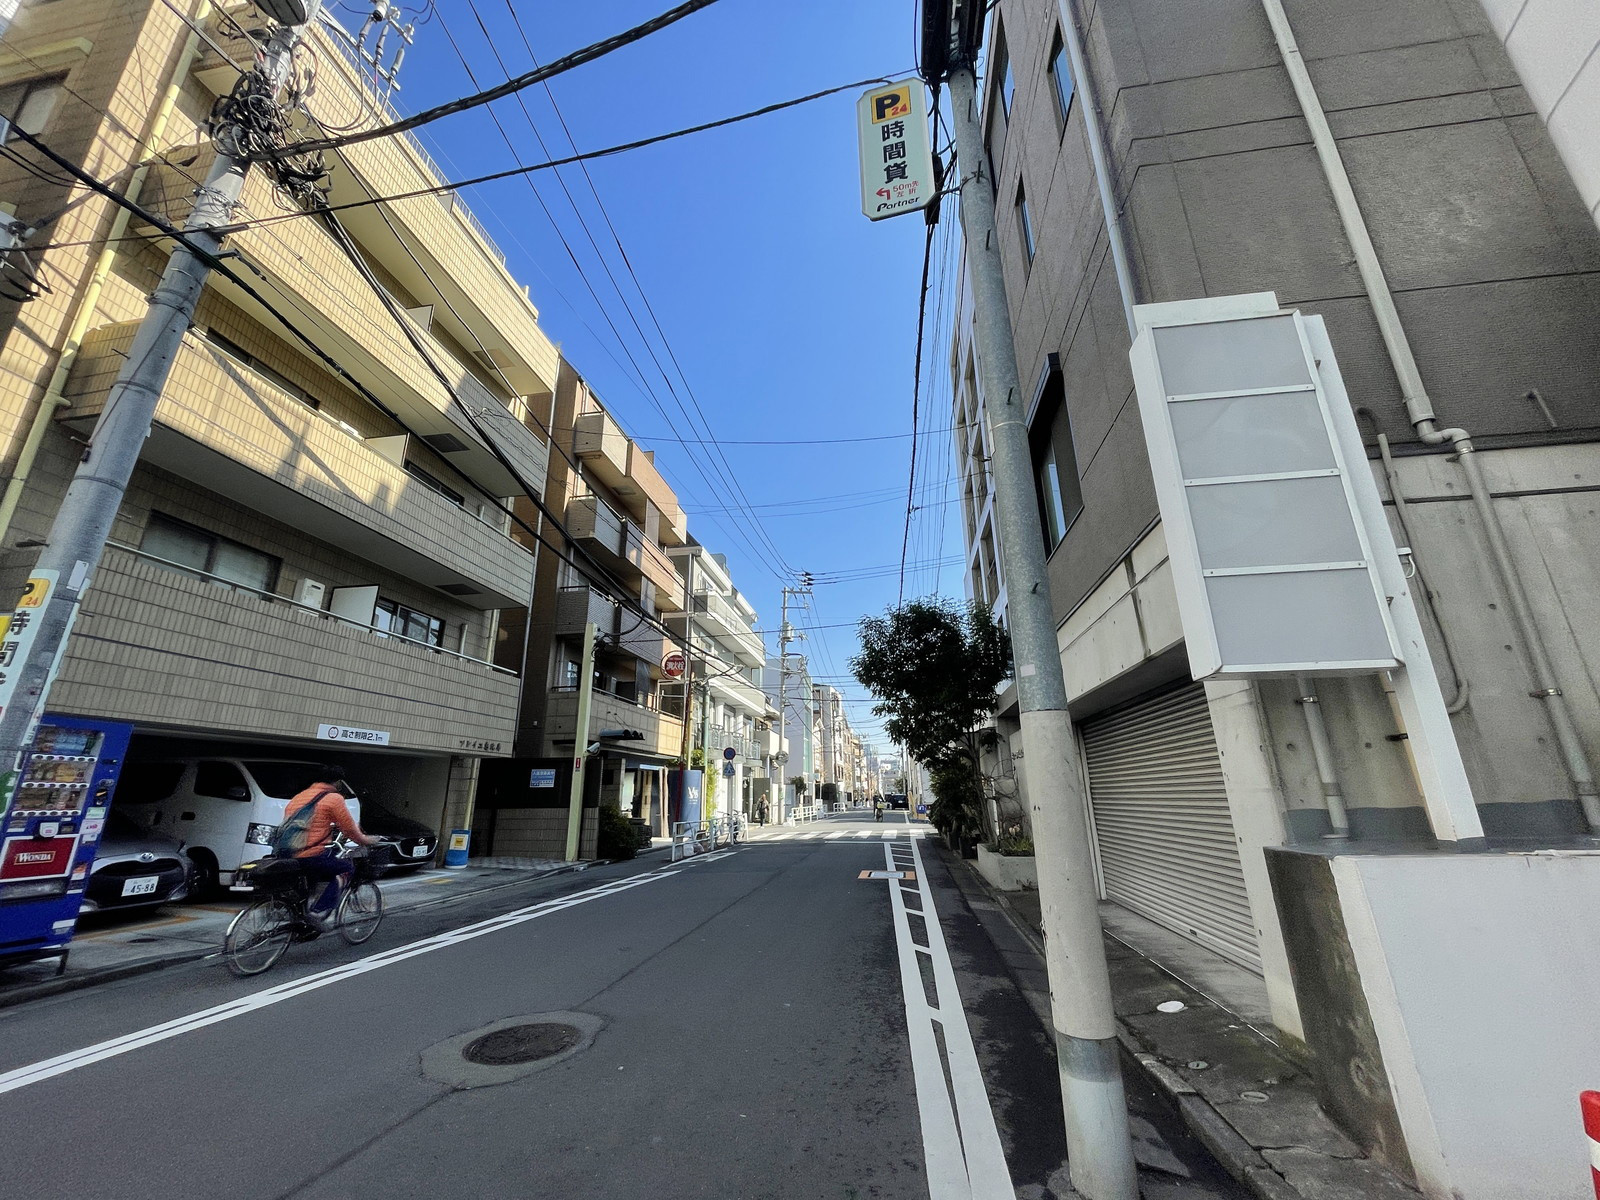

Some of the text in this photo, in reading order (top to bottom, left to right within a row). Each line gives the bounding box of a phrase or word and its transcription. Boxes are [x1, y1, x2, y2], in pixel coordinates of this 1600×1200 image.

[876, 93, 908, 120] P 24
[881, 121, 908, 184] 時間貸
[877, 196, 920, 212] Partner
[25, 597, 39, 606] 24
[666, 661, 685, 670] 消火栓
[18, 852, 51, 863] WONDA
[130, 883, 155, 893] 45-88
